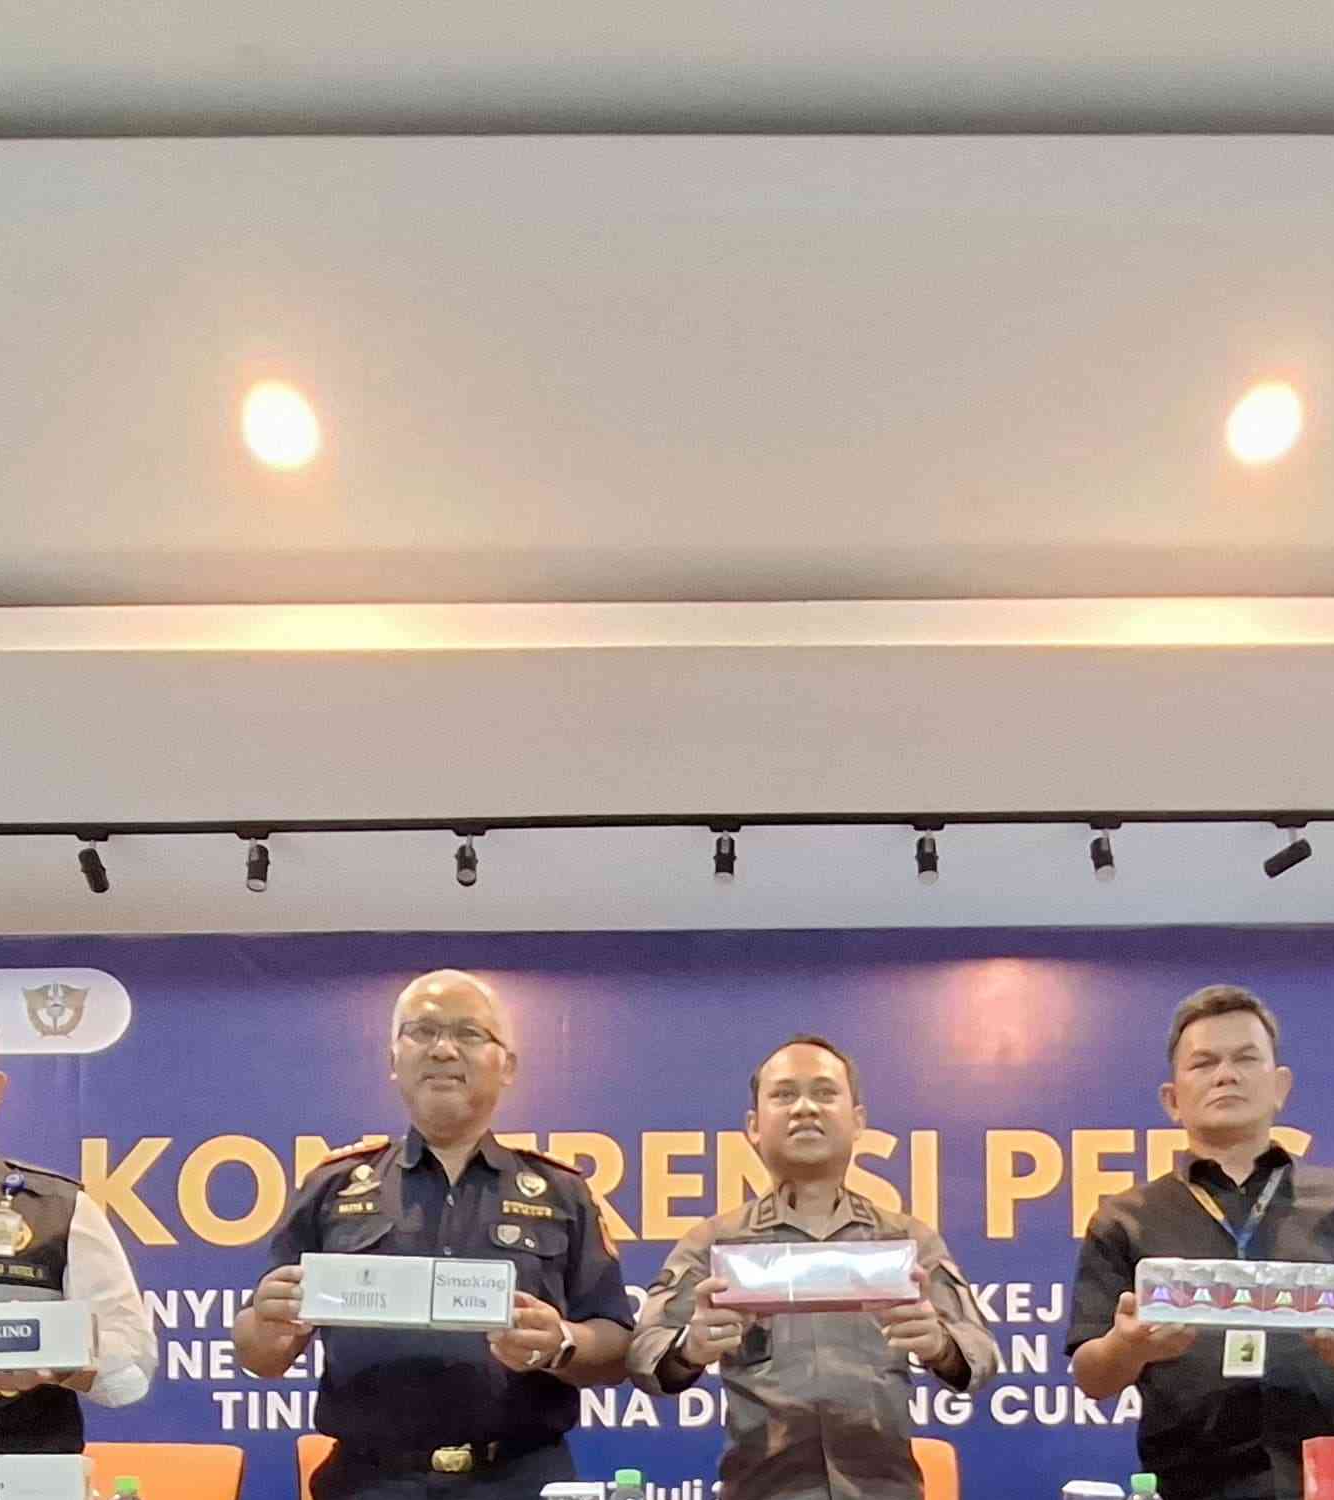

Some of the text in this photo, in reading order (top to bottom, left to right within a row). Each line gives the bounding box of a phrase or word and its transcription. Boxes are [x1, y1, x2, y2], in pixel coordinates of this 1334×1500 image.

[81, 1128, 1313, 1246] KORENSI PE
[435, 1274, 507, 1291] Smoking
[452, 1296, 487, 1309] Kills
[212, 1391, 317, 1431] TIN
[990, 1384, 1142, 1425] CUKA
